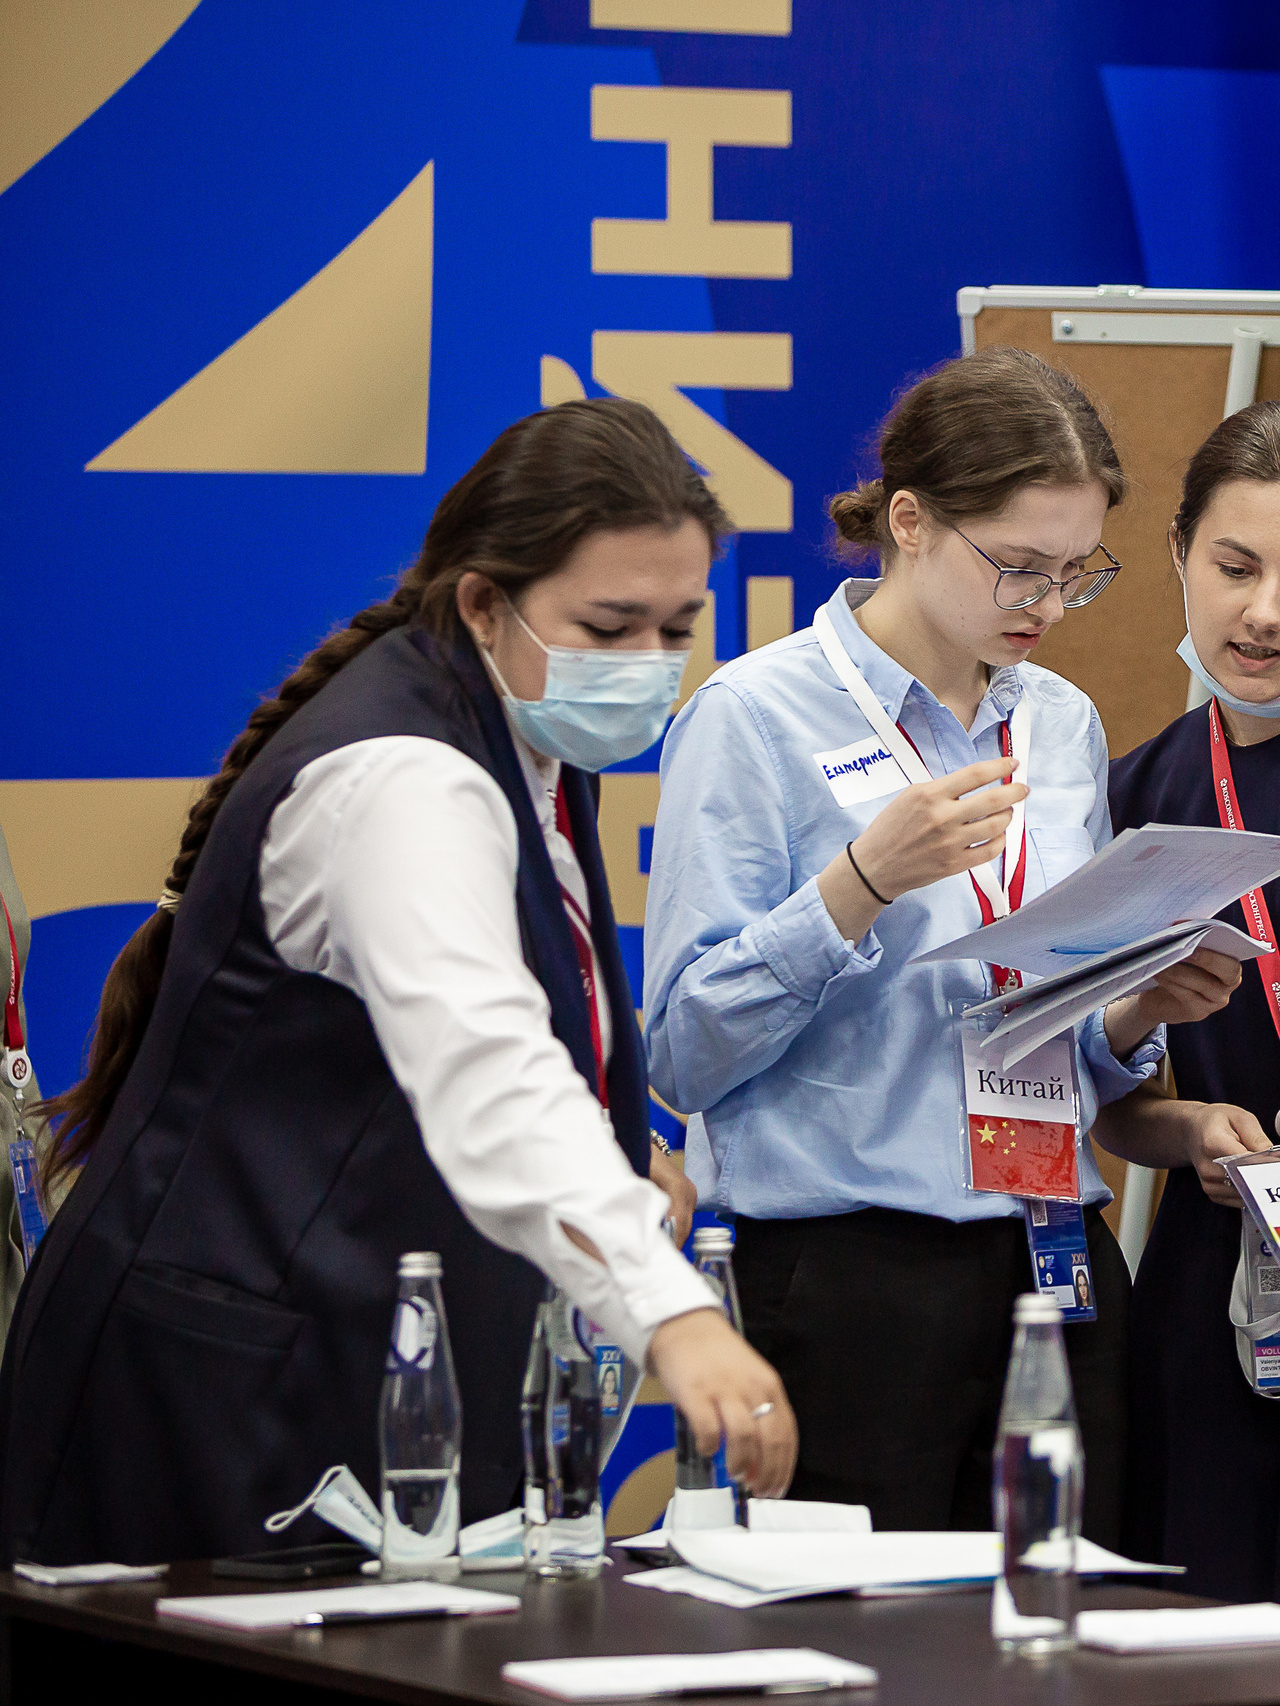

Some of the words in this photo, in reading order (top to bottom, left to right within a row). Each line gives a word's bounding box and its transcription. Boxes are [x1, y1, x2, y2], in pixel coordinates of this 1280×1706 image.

[823, 748, 893, 781] Екатерина
[1247, 889, 1267, 940] ОСКОНГРЕСС
[977, 1069, 1065, 1101] Китай
